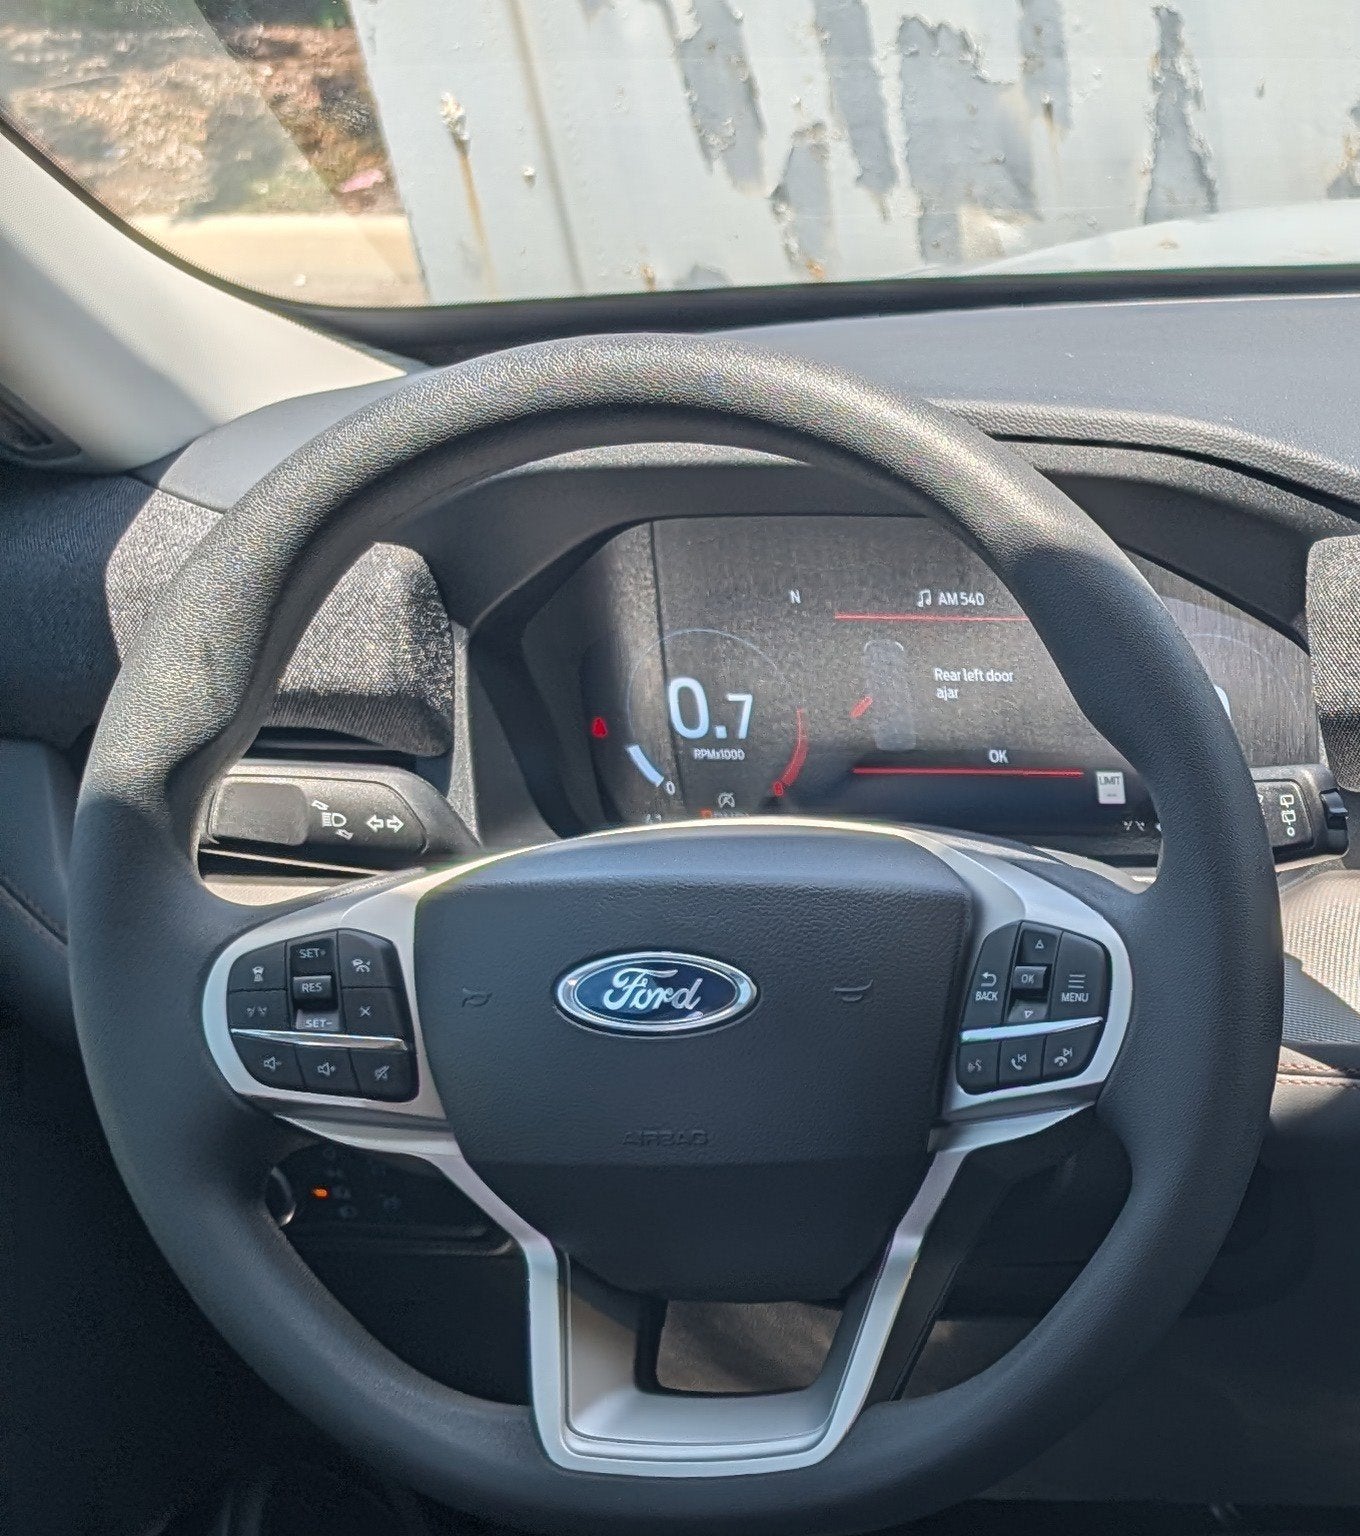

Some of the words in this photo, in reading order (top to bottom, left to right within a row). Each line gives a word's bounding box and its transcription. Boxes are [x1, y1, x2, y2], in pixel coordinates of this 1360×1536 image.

[789, 590, 802, 604] N
[938, 592, 958, 606] AM
[960, 592, 985, 606] 540
[934, 668, 962, 682] Rear
[963, 668, 984, 682] left
[986, 668, 1014, 683] door
[936, 688, 960, 701] ajar
[668, 676, 754, 740] 0.7
[988, 750, 1009, 764] OK
[666, 780, 676, 795] 0
[1098, 776, 1120, 786] LIMIT
[1021, 974, 1035, 984] OK
[302, 982, 322, 992] RES
[602, 966, 704, 1010] Ford
[975, 991, 998, 1001] BACK
[1061, 992, 1090, 1002] MENU
[305, 1018, 333, 1028] SET-
